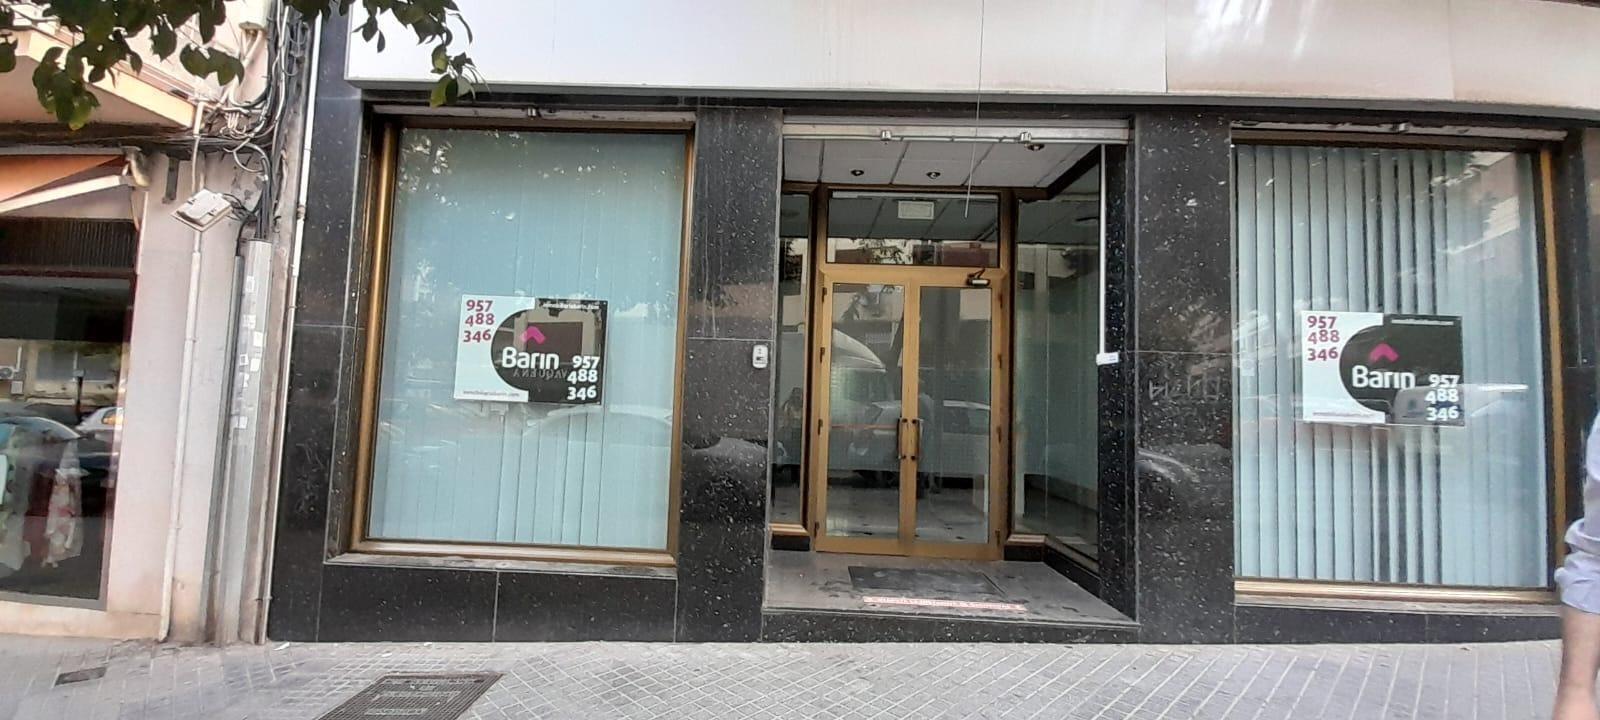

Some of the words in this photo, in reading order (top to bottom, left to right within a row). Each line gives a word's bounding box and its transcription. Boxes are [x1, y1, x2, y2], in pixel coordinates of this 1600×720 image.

[466, 300, 493, 312] 957
[465, 313, 494, 327] 488
[1307, 316, 1337, 329] 957
[463, 329, 492, 343] 346
[1307, 330, 1340, 344] 488
[502, 347, 559, 370] Barin
[1307, 347, 1339, 361] 346
[572, 355, 600, 368] 957
[567, 369, 598, 384] 488
[1352, 365, 1416, 389] Barin
[1428, 374, 1460, 387] 957
[567, 386, 597, 400] 346
[1425, 389, 1459, 404] 488
[1426, 406, 1459, 421] 346
